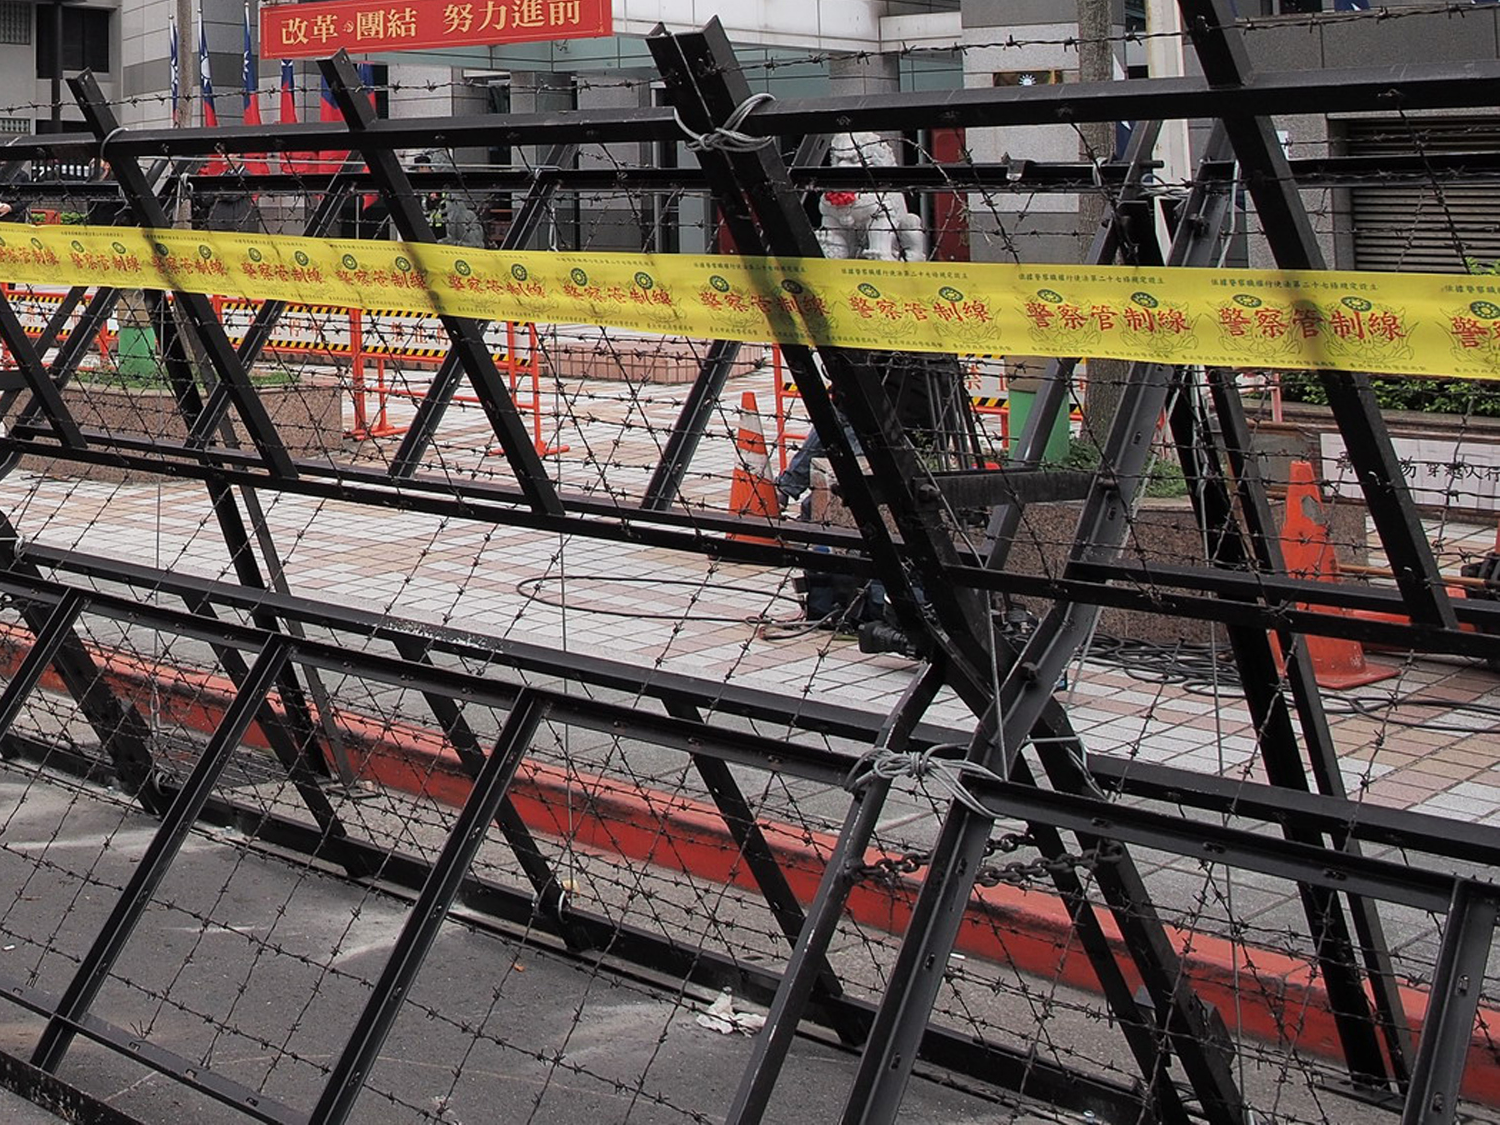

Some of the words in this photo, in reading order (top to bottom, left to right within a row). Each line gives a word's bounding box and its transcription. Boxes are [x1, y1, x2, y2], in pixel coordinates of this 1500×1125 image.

[280, 13, 339, 46] 改革
[355, 6, 418, 41] 團結
[563, 283, 673, 307] 警察管制線
[700, 289, 830, 319] 警察管制線
[850, 296, 994, 324] 警察管制線
[1025, 302, 1192, 334] 警察管制線
[1219, 307, 1407, 342] 警察管制線
